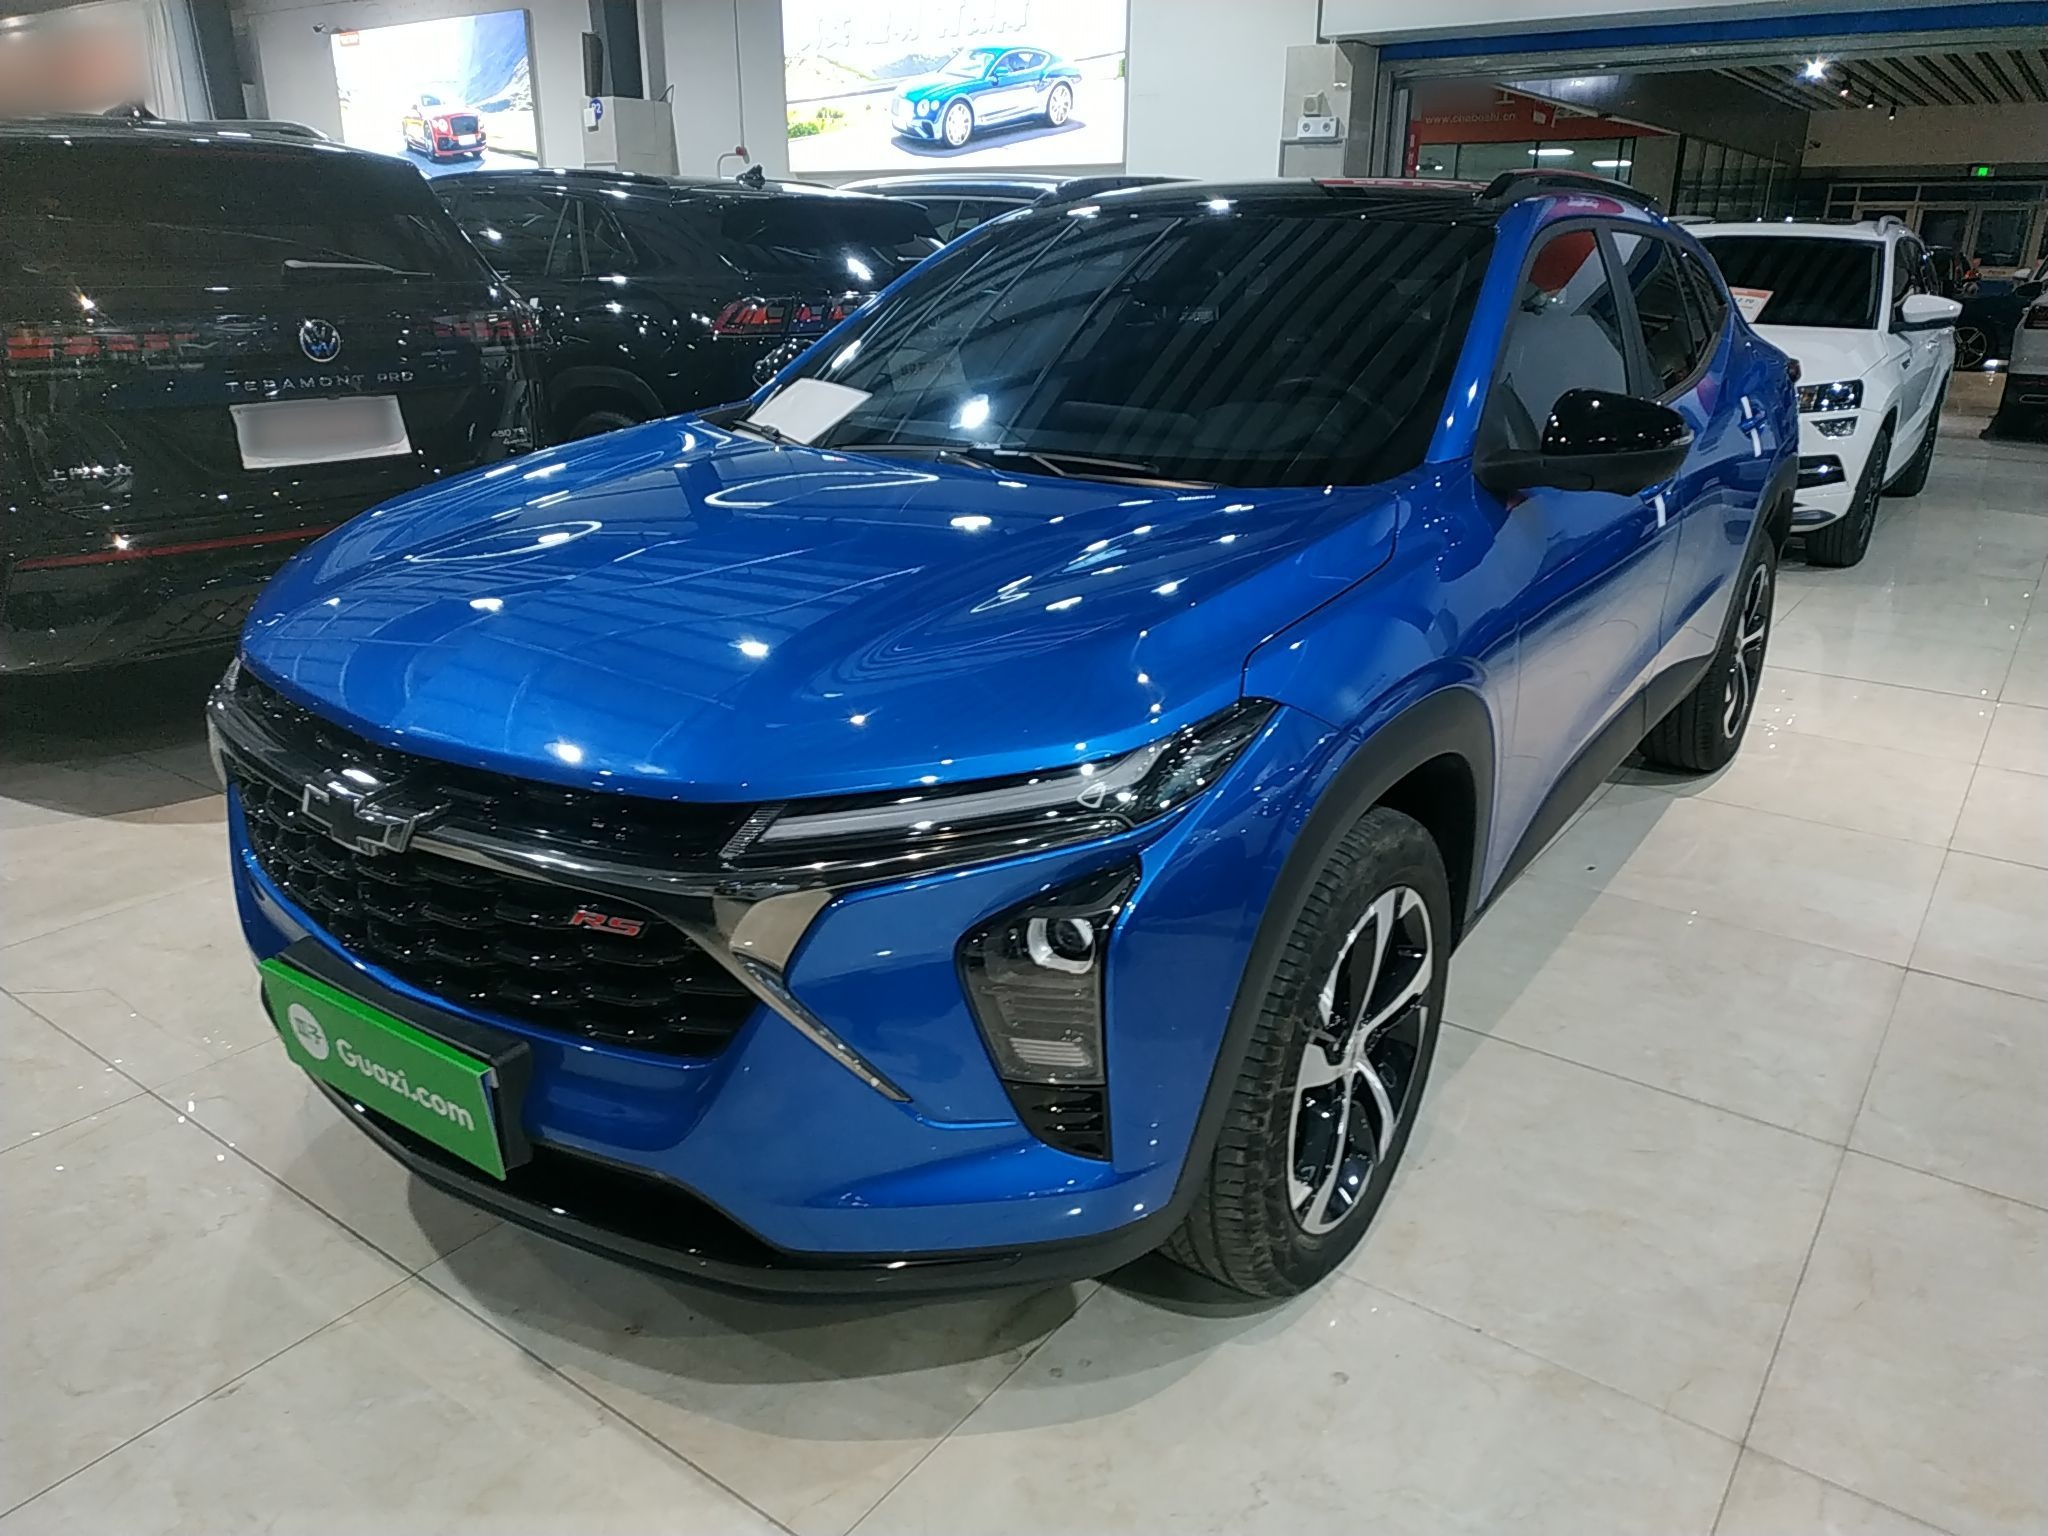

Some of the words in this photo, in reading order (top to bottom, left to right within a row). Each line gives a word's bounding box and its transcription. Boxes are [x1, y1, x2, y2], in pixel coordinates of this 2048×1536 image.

[224, 373, 366, 394] TERAMONT
[376, 370, 414, 384] PRO
[568, 909, 646, 937] RS
[335, 1038, 476, 1133] Guazi.com
